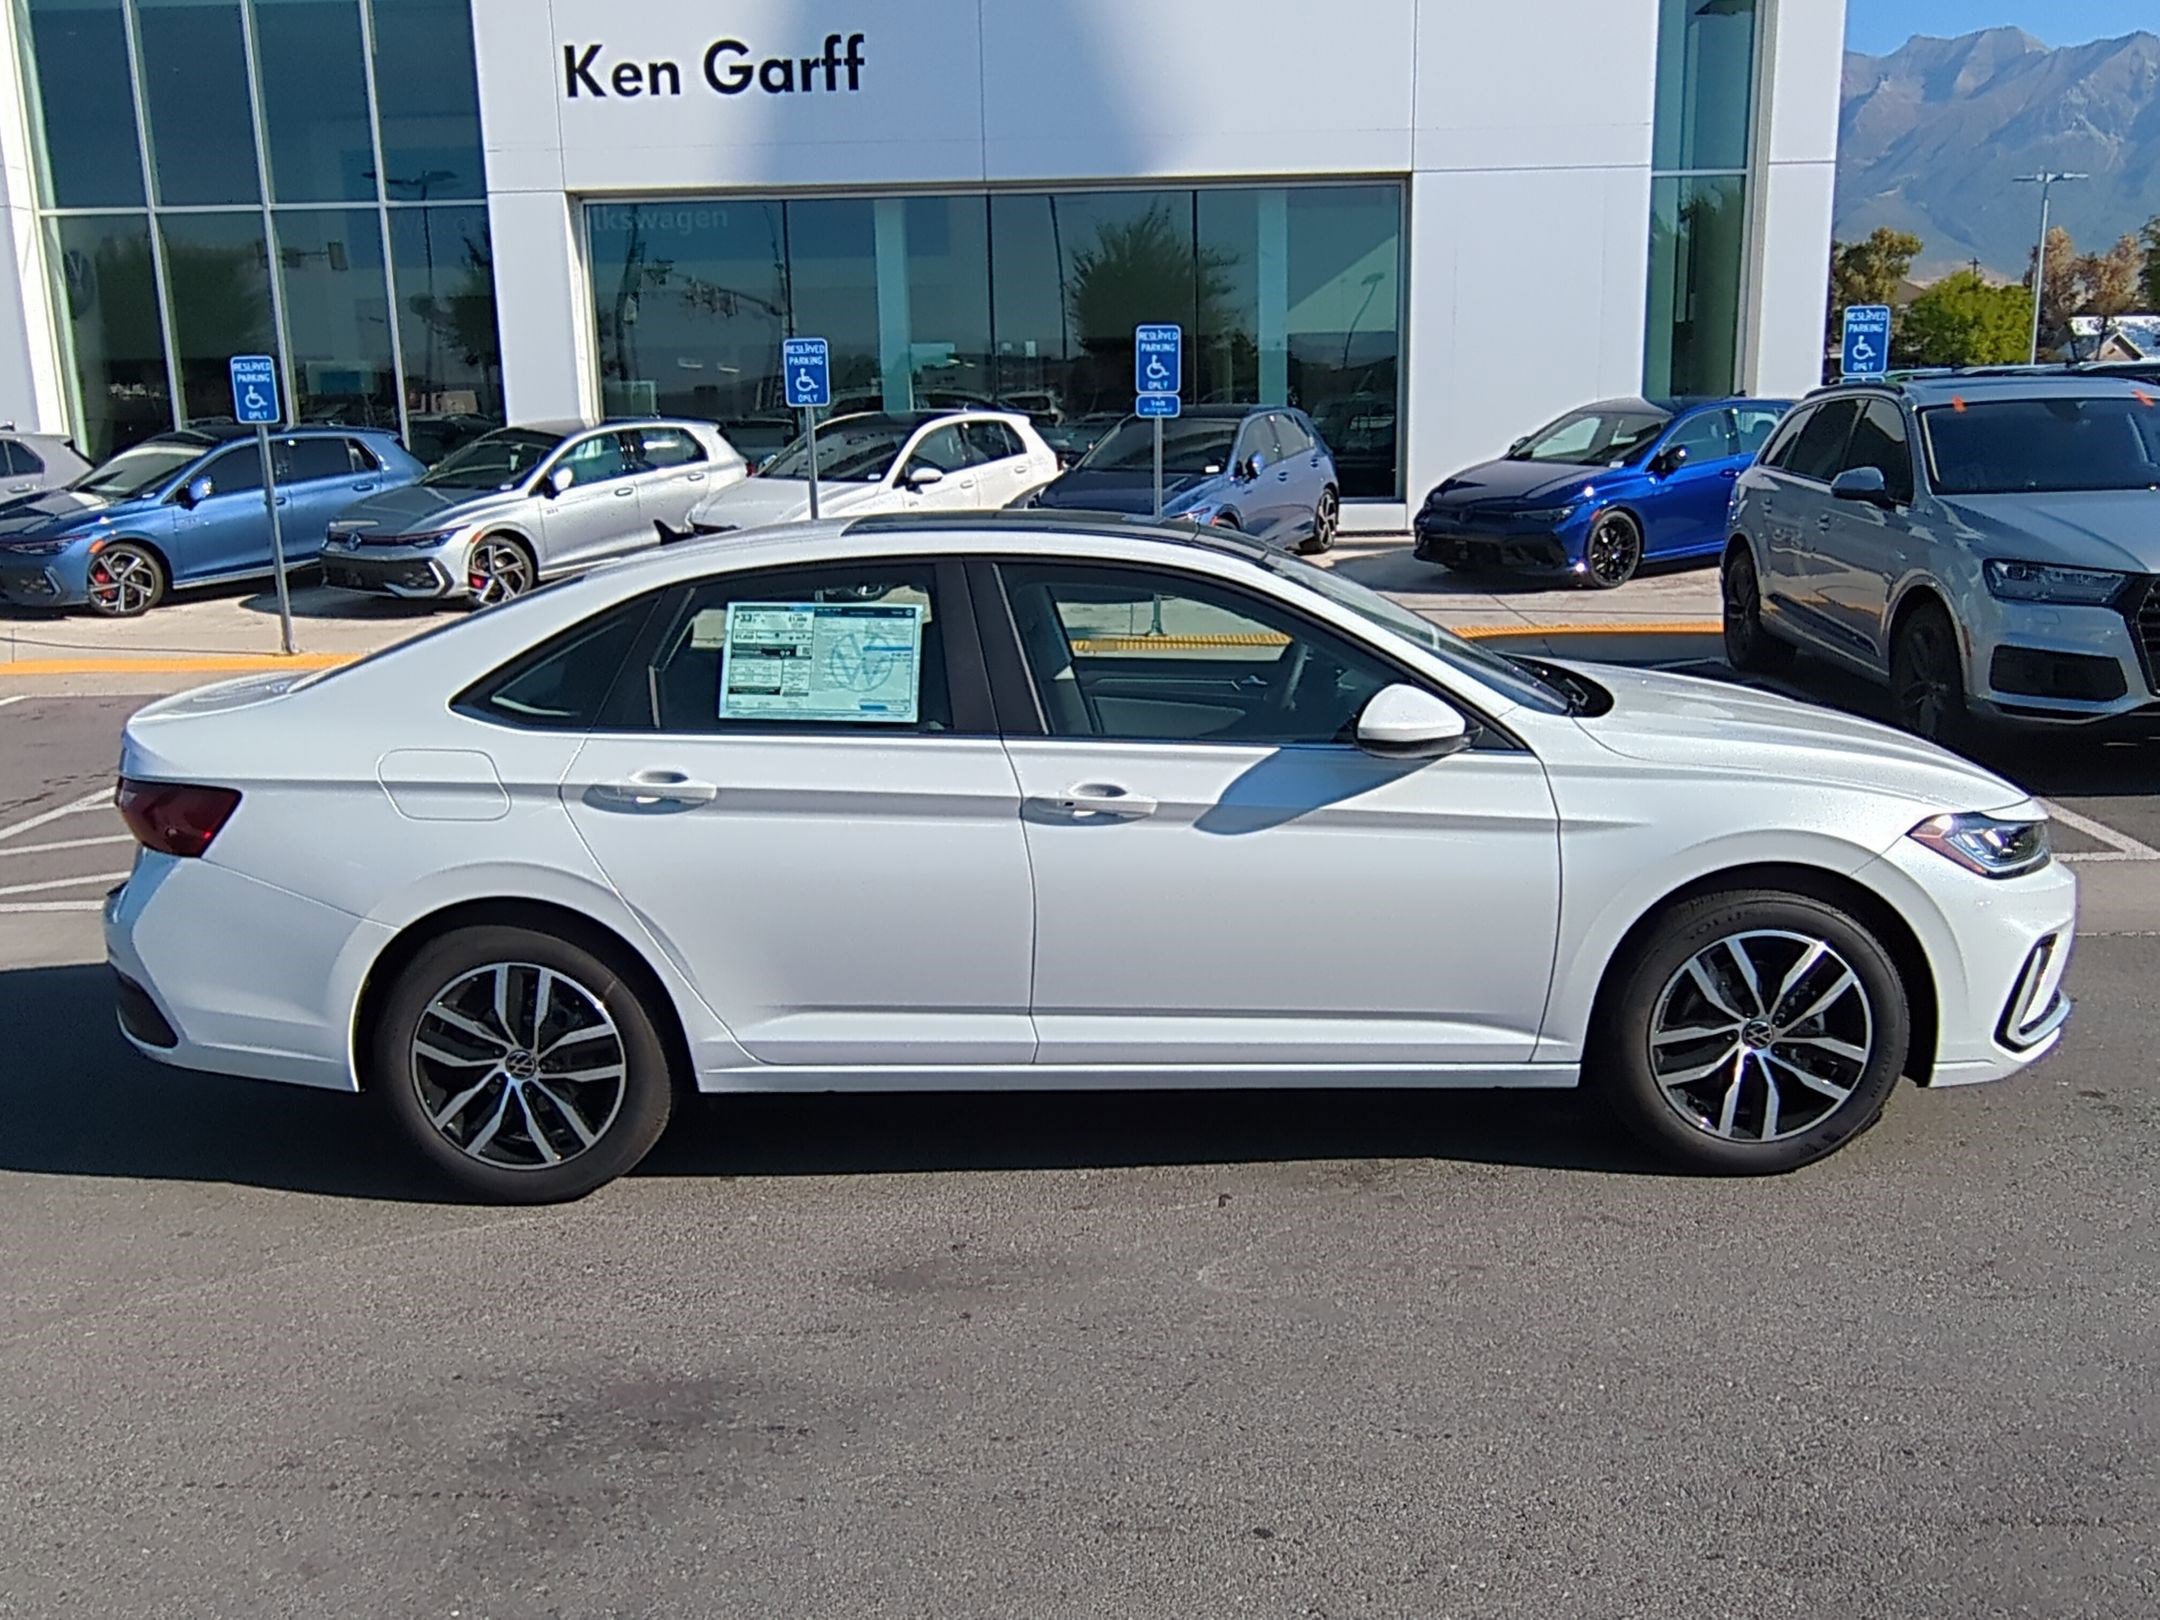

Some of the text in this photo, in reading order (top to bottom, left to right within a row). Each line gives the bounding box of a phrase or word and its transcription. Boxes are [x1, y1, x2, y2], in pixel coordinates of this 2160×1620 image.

[563, 33, 866, 98] Ken Garff
[591, 205, 730, 235] lkswagen
[1848, 323, 1884, 333] PARKING
[1141, 343, 1176, 352] PARKING
[788, 356, 823, 366] PARKING
[236, 373, 270, 383] PARKING
[1147, 381, 1168, 390] ONLY
